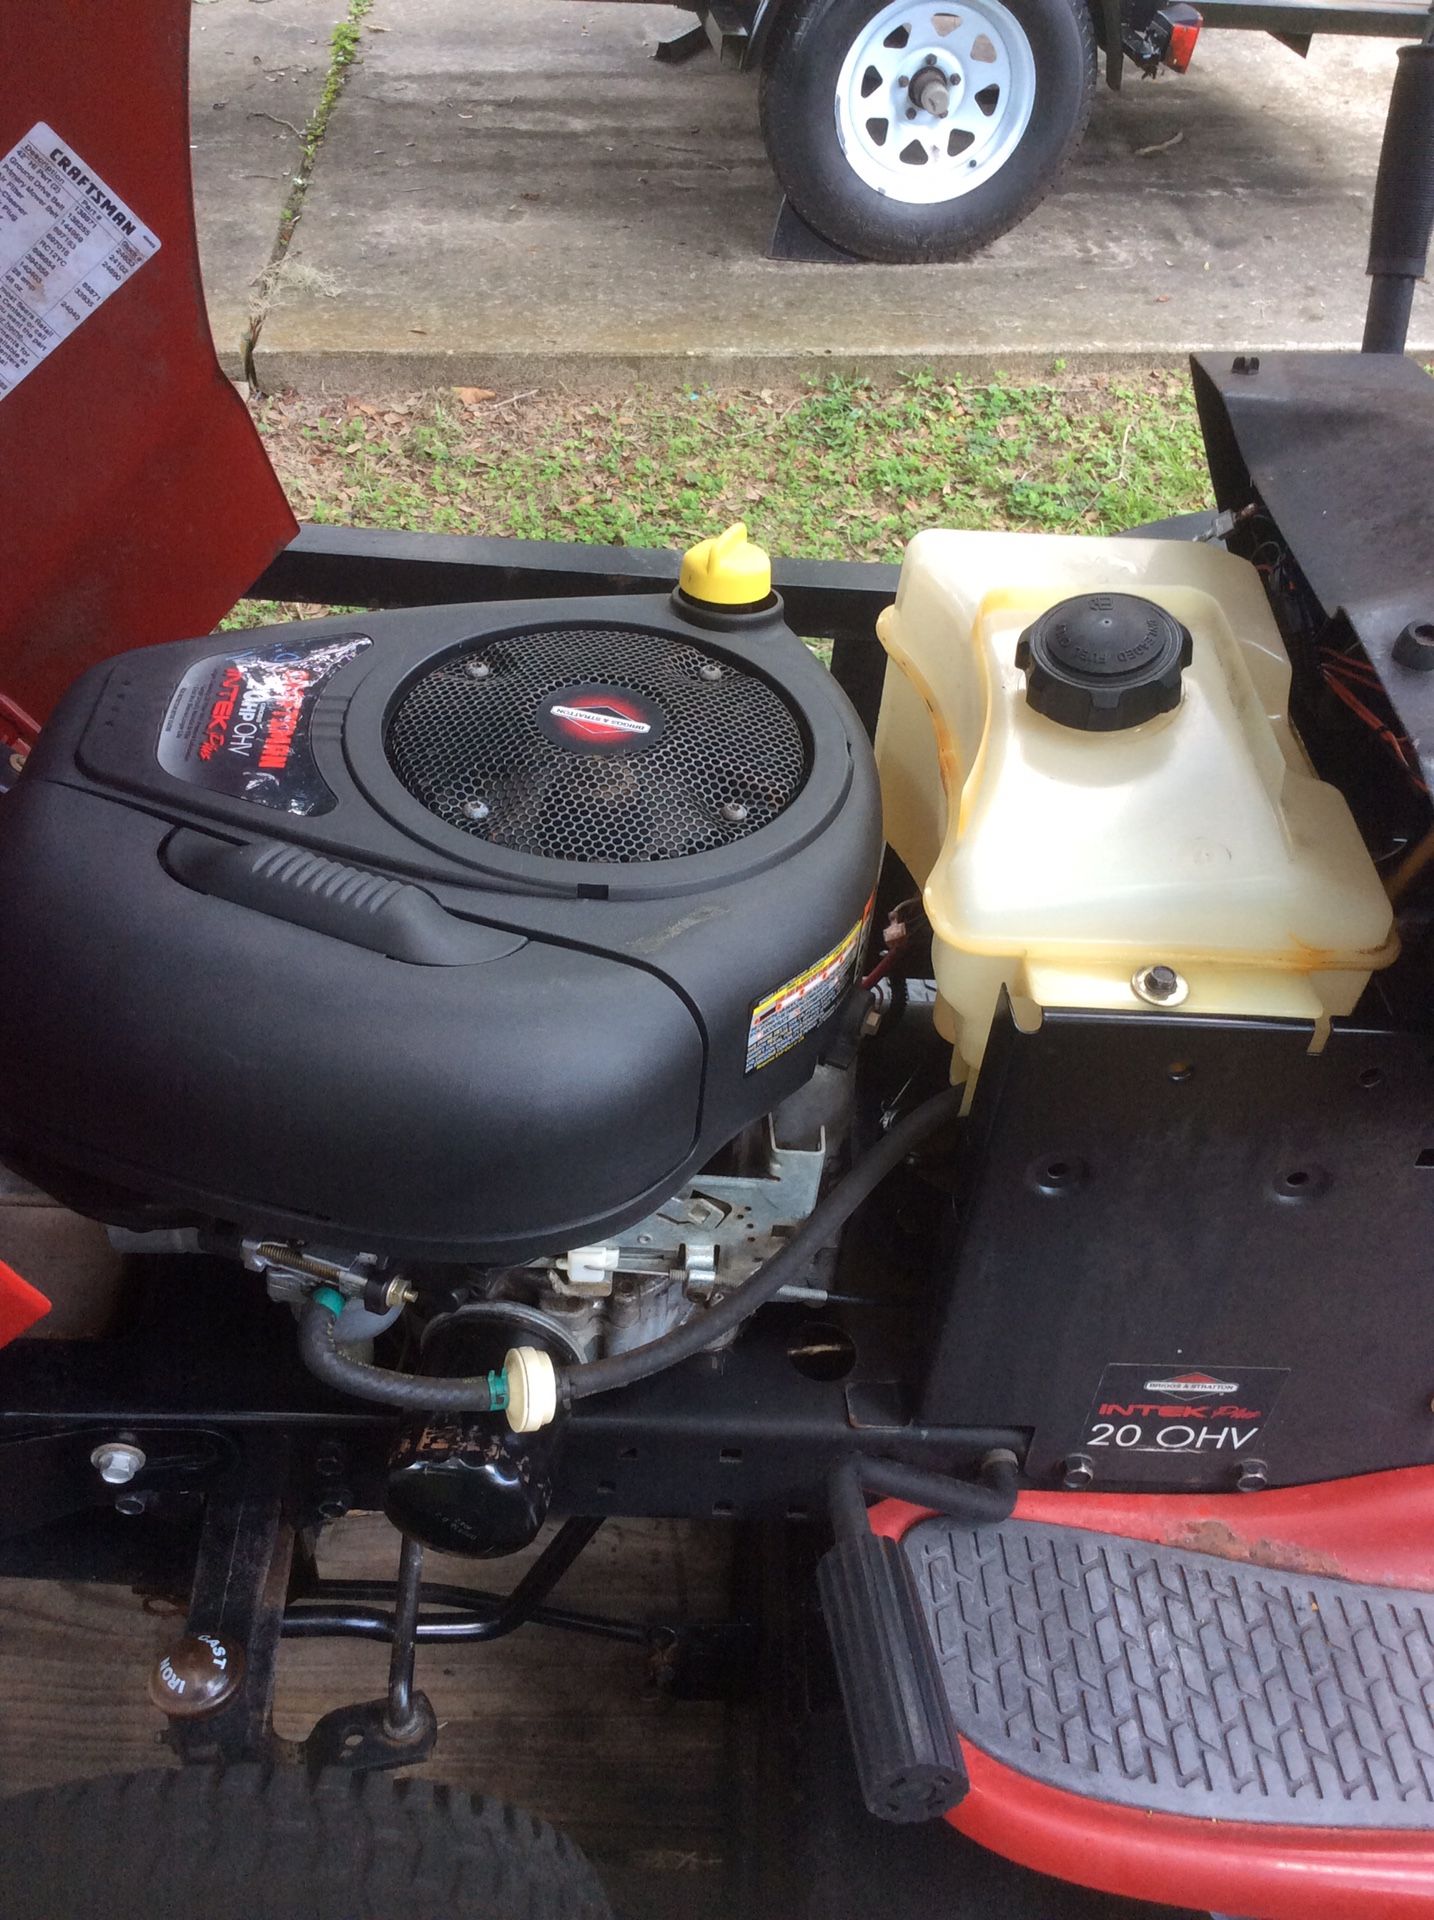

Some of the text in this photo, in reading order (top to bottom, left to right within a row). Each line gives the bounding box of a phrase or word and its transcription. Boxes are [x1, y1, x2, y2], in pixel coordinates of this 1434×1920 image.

[2, 164, 26, 187] Primary
[26, 186, 46, 206] Mower
[45, 205, 59, 218] Belt
[7, 182, 24, 198] Filter
[10, 157, 35, 182] Ground
[34, 180, 51, 198] Drive
[51, 196, 65, 211] Belt
[25, 144, 65, 184] Description
[81, 200, 96, 215] Part
[50, 148, 136, 236] CRAFTSMAN
[2, 205, 18, 221] Plug
[2, 298, 26, 322] Centers
[22, 327, 33, 338] the
[32, 338, 47, 351] part
[35, 318, 54, 337] Retail
[207, 667, 241, 731] INTEK
[228, 722, 257, 757] OHV
[1149, 1382, 1181, 1390] BRIGGS
[1190, 1382, 1234, 1391] STRATTON
[1098, 1403, 1209, 1418] INTEK
[1087, 1423, 1259, 1450] 20 OHV
[160, 1656, 186, 1694] IRON
